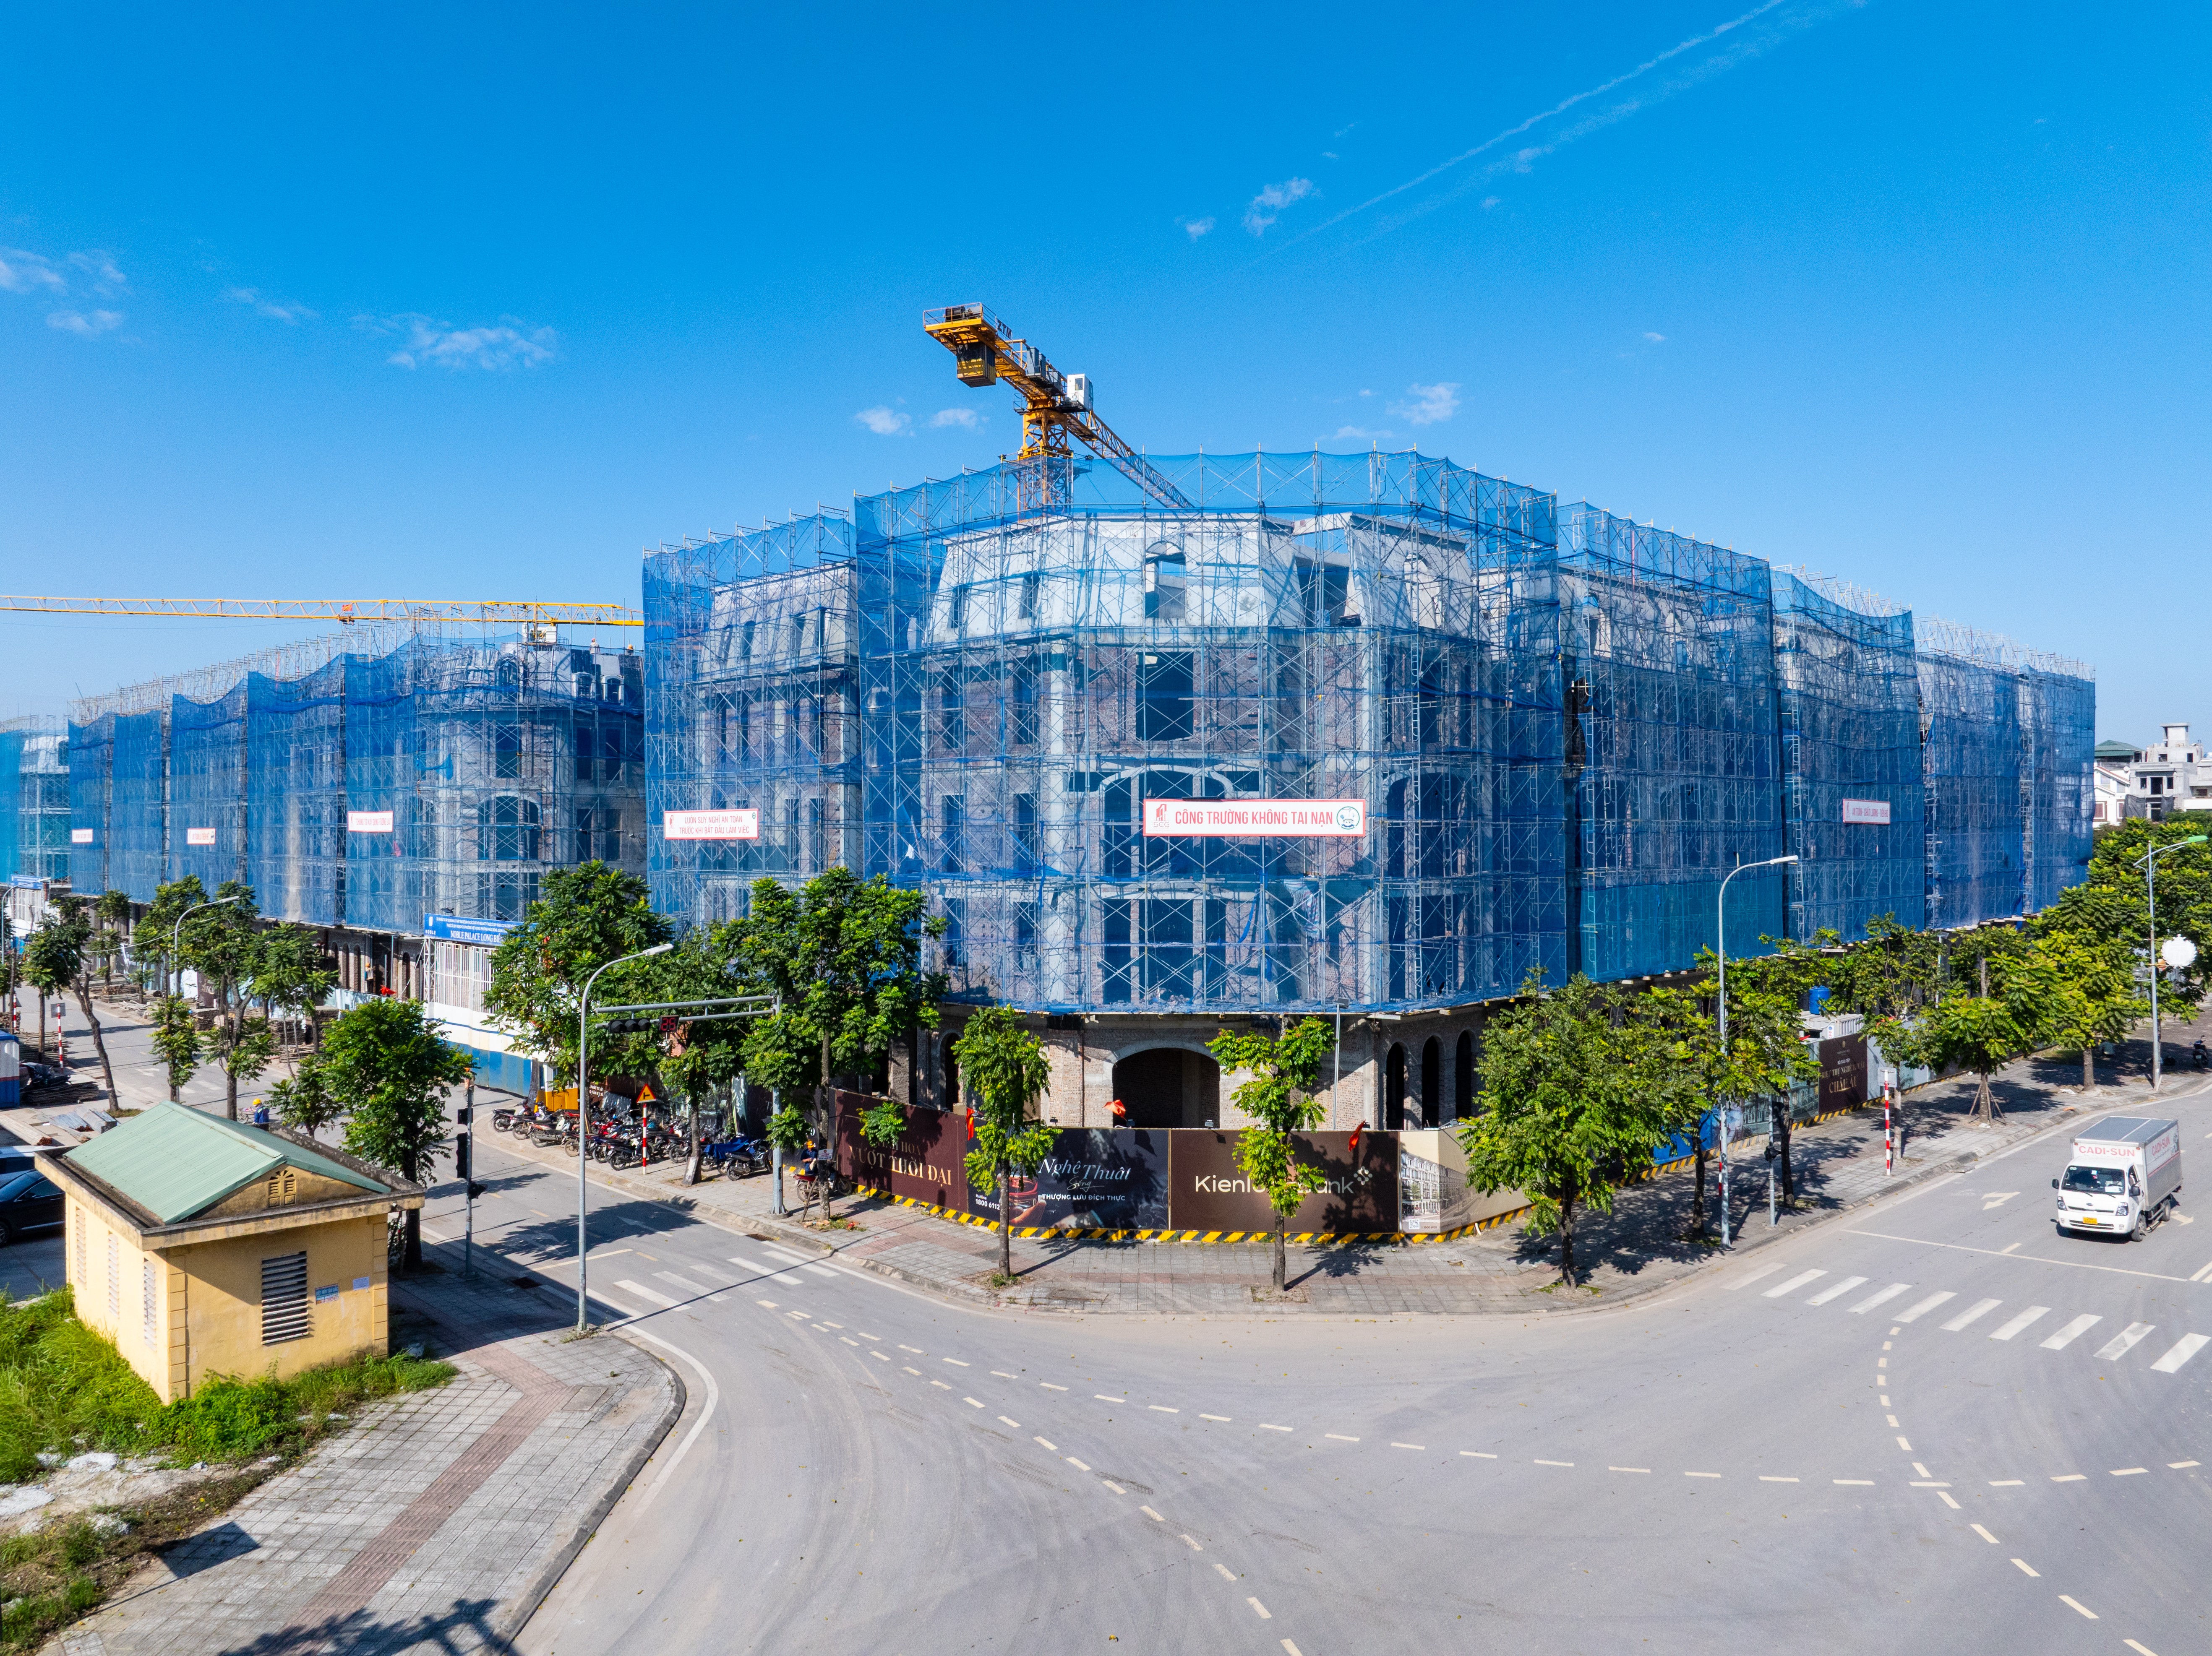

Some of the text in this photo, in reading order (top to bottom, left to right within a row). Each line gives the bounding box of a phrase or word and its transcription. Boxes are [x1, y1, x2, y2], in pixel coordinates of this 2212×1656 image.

[685, 815, 696, 824] LUÔN
[708, 815, 720, 823] NGHĨ
[730, 814, 743, 823] TOÀN
[1175, 808, 1333, 827] CÔNG TRƯỜNG KHÔNG TAI NẠN
[679, 825, 694, 834] TRƯỚC
[726, 825, 736, 834] LÀM
[738, 825, 749, 835] VIỆC
[450, 930, 464, 939] NOBLE
[464, 932, 480, 941] PALACE
[481, 933, 493, 942] LONG
[661, 1017, 676, 1031] 25
[2079, 1146, 2135, 1156] CADI-SUN
[848, 1145, 952, 1187] VƯỢT THỜI ĐẠI
[1067, 1176, 1104, 1193] Sống
[976, 1198, 988, 1207] 1800
